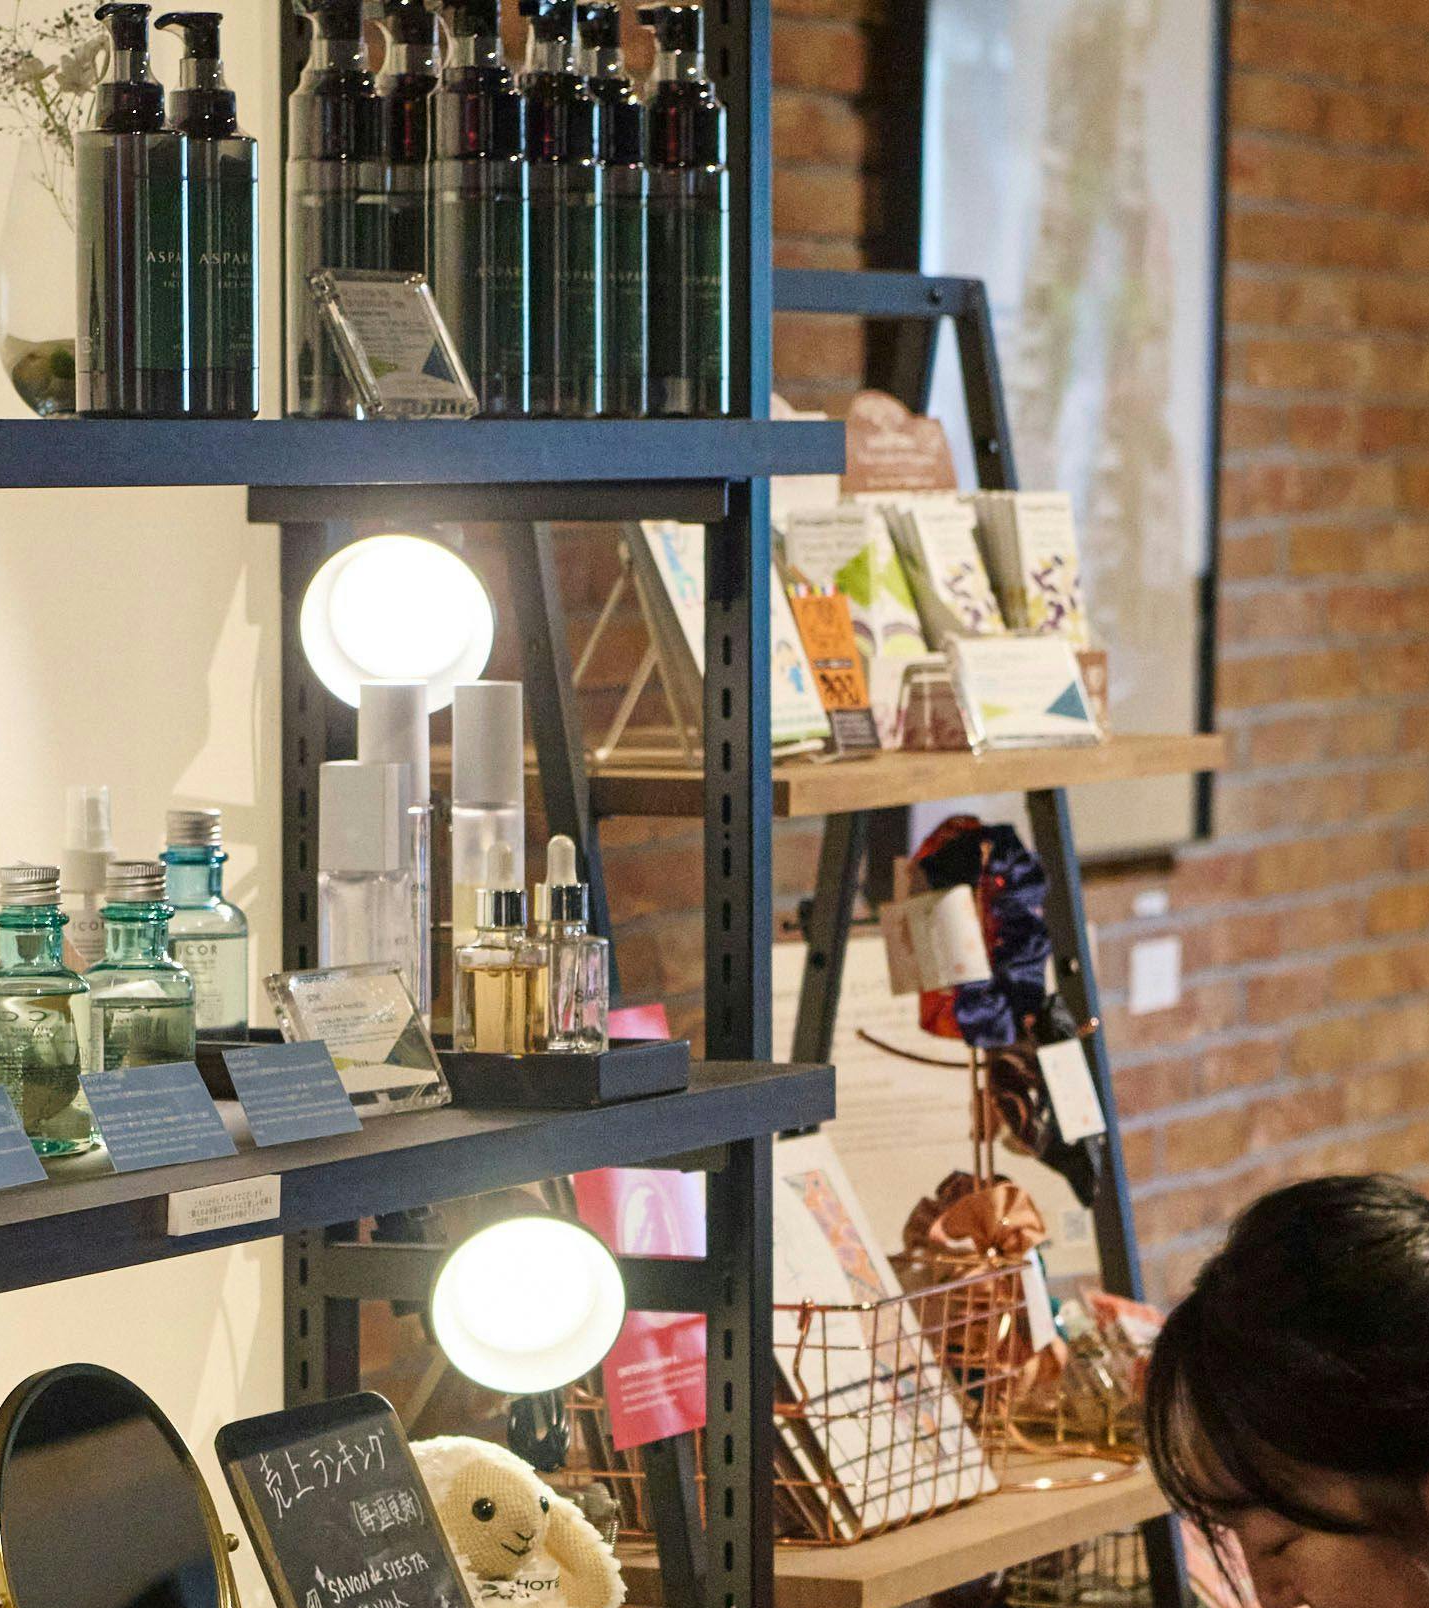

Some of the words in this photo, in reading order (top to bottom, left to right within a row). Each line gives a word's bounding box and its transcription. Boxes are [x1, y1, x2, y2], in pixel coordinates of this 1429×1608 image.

[259, 1427, 386, 1519] 売上ランキング
[327, 1572, 372, 1604] SAVON
[370, 1564, 383, 1586] de
[382, 1551, 430, 1580] SIESTA
